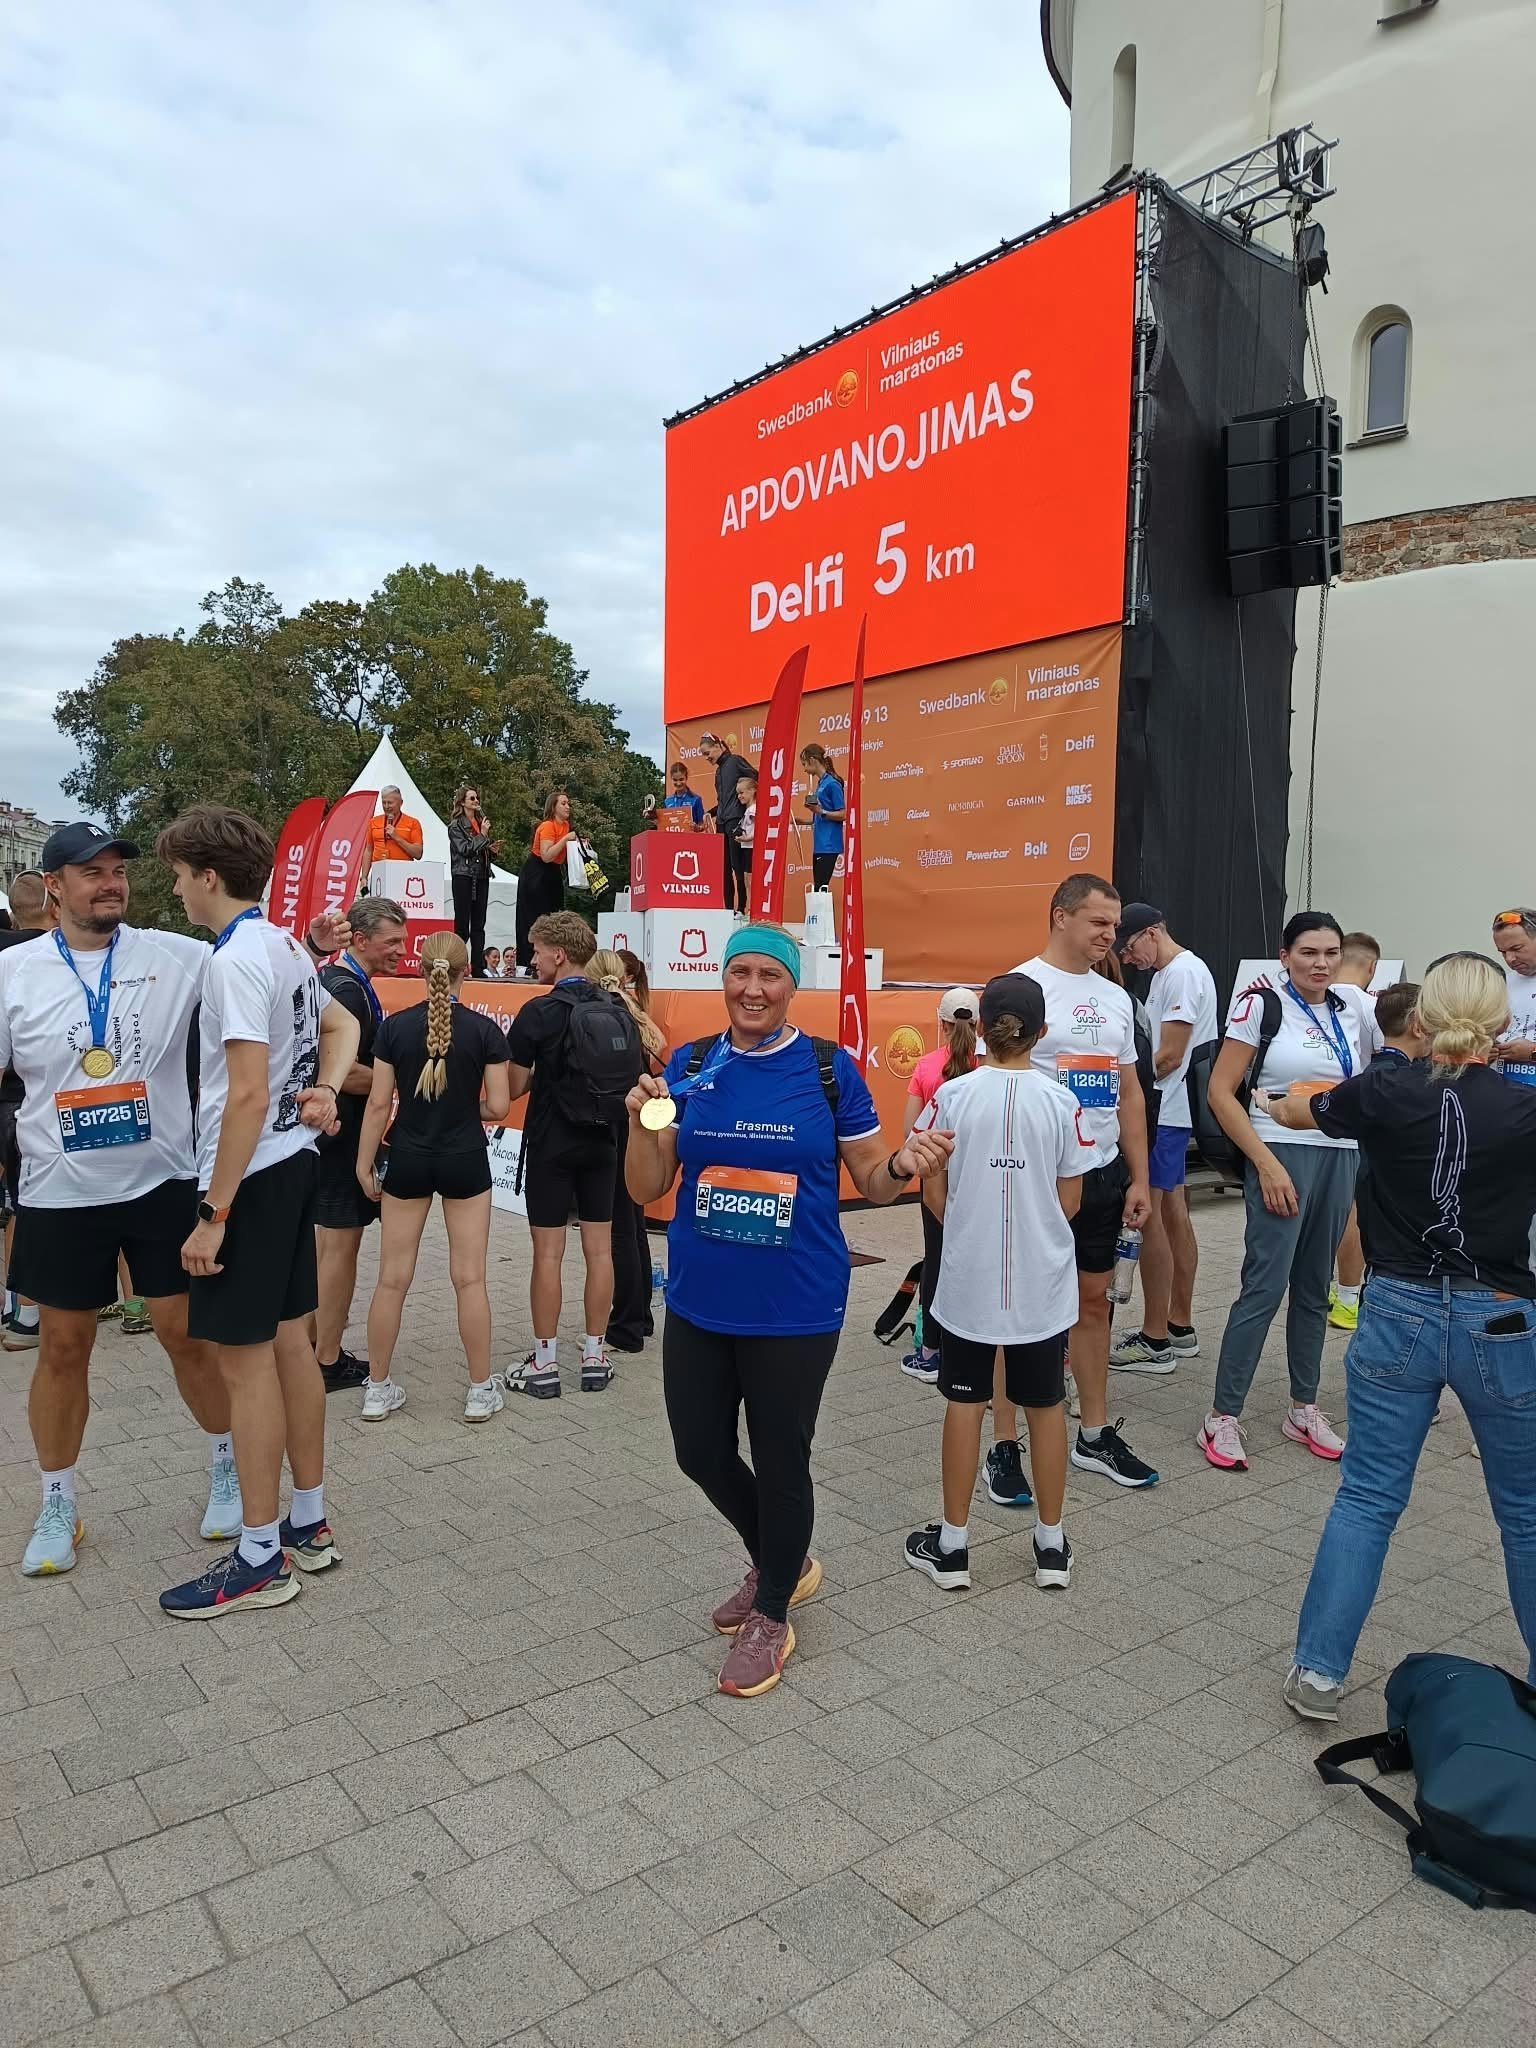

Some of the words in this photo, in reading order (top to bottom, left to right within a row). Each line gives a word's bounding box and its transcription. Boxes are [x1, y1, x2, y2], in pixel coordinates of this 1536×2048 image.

[879, 330, 941, 369] Vilniaus
[879, 341, 964, 393] maratonas
[757, 388, 833, 439] Swedbank
[720, 368, 1035, 537] APDOVANOJIMAS
[750, 551, 844, 633] Delfi
[873, 520, 908, 595] 5
[926, 542, 975, 582] km
[1027, 663, 1080, 685] Vilniaus
[1026, 676, 1100, 702] maratonas
[919, 688, 986, 715] Swedbank
[819, 712, 851, 733] 2026
[875, 706, 888, 723] 13
[1000, 743, 1024, 755] DAILY
[1066, 735, 1095, 752] Delfi
[996, 752, 1025, 765] SPOON
[880, 769, 908, 780] Jaunimo
[1007, 795, 1045, 807] GARMIN
[1065, 794, 1093, 805] BICEPS
[906, 808, 929, 820] Ricola
[966, 849, 1010, 861] Powerbar
[1024, 841, 1048, 857] Bolt
[662, 883, 710, 895] VILNIUS
[397, 901, 434, 910] VILNIUS
[668, 962, 719, 972] VILNIUS
[112, 1016, 122, 1068] MANIFESTING
[132, 1013, 141, 1065] PORSCHE
[1506, 1063, 1536, 1075] 11883
[1072, 1073, 1108, 1088] 12641
[78, 1105, 132, 1127] 31725
[735, 1121, 796, 1133] Erasmus+
[711, 1192, 776, 1217] 32648
